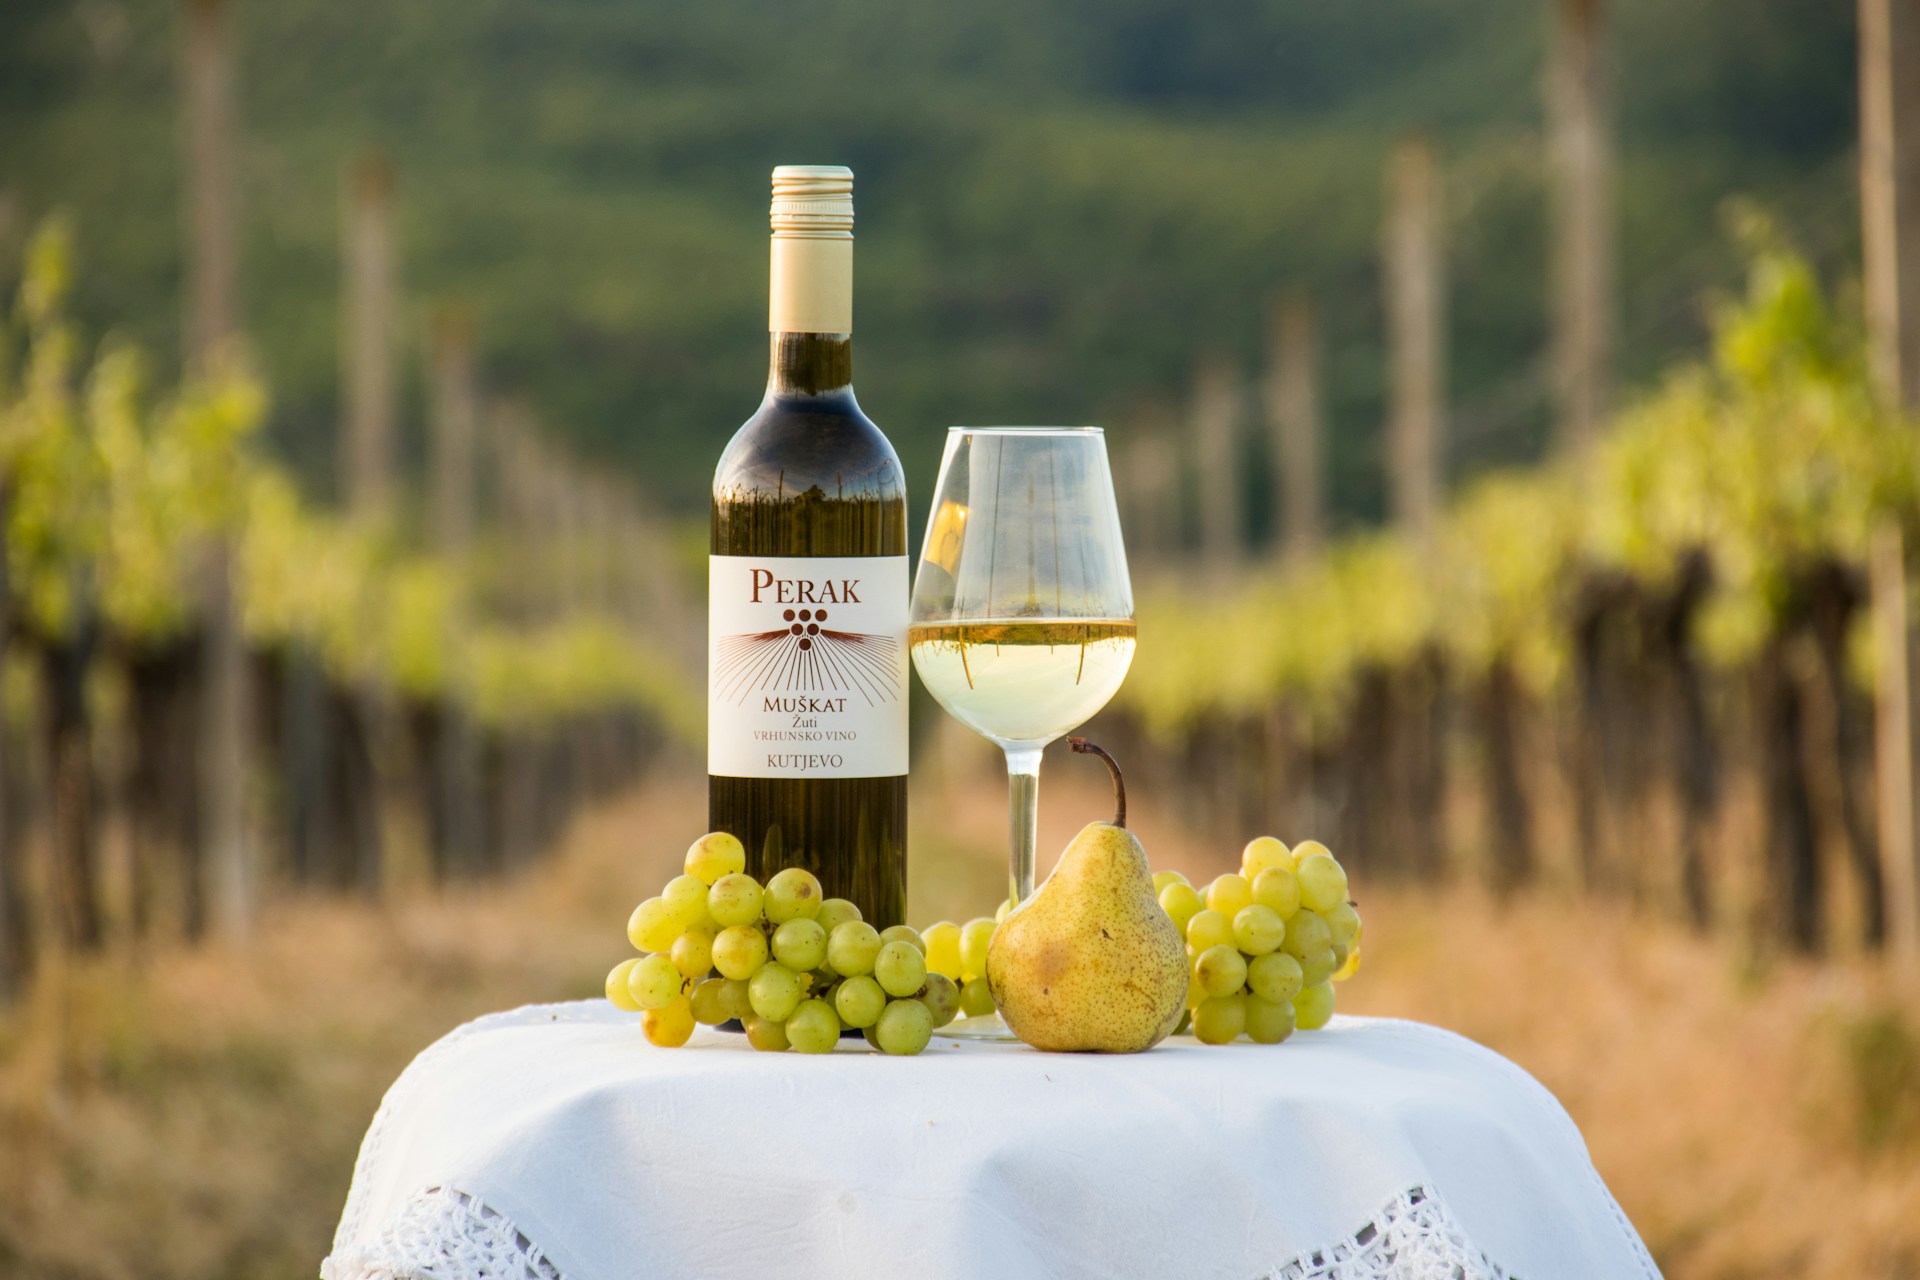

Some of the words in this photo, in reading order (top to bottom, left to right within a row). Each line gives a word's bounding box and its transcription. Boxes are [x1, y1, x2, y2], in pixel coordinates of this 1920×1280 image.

[750, 568, 862, 604] PERAK
[763, 695, 847, 713] MUŠKAT
[792, 714, 818, 728] Žuti
[753, 731, 823, 741] VRHUNSKO
[825, 731, 857, 741] VINO
[767, 754, 843, 771] KUTJEVO
